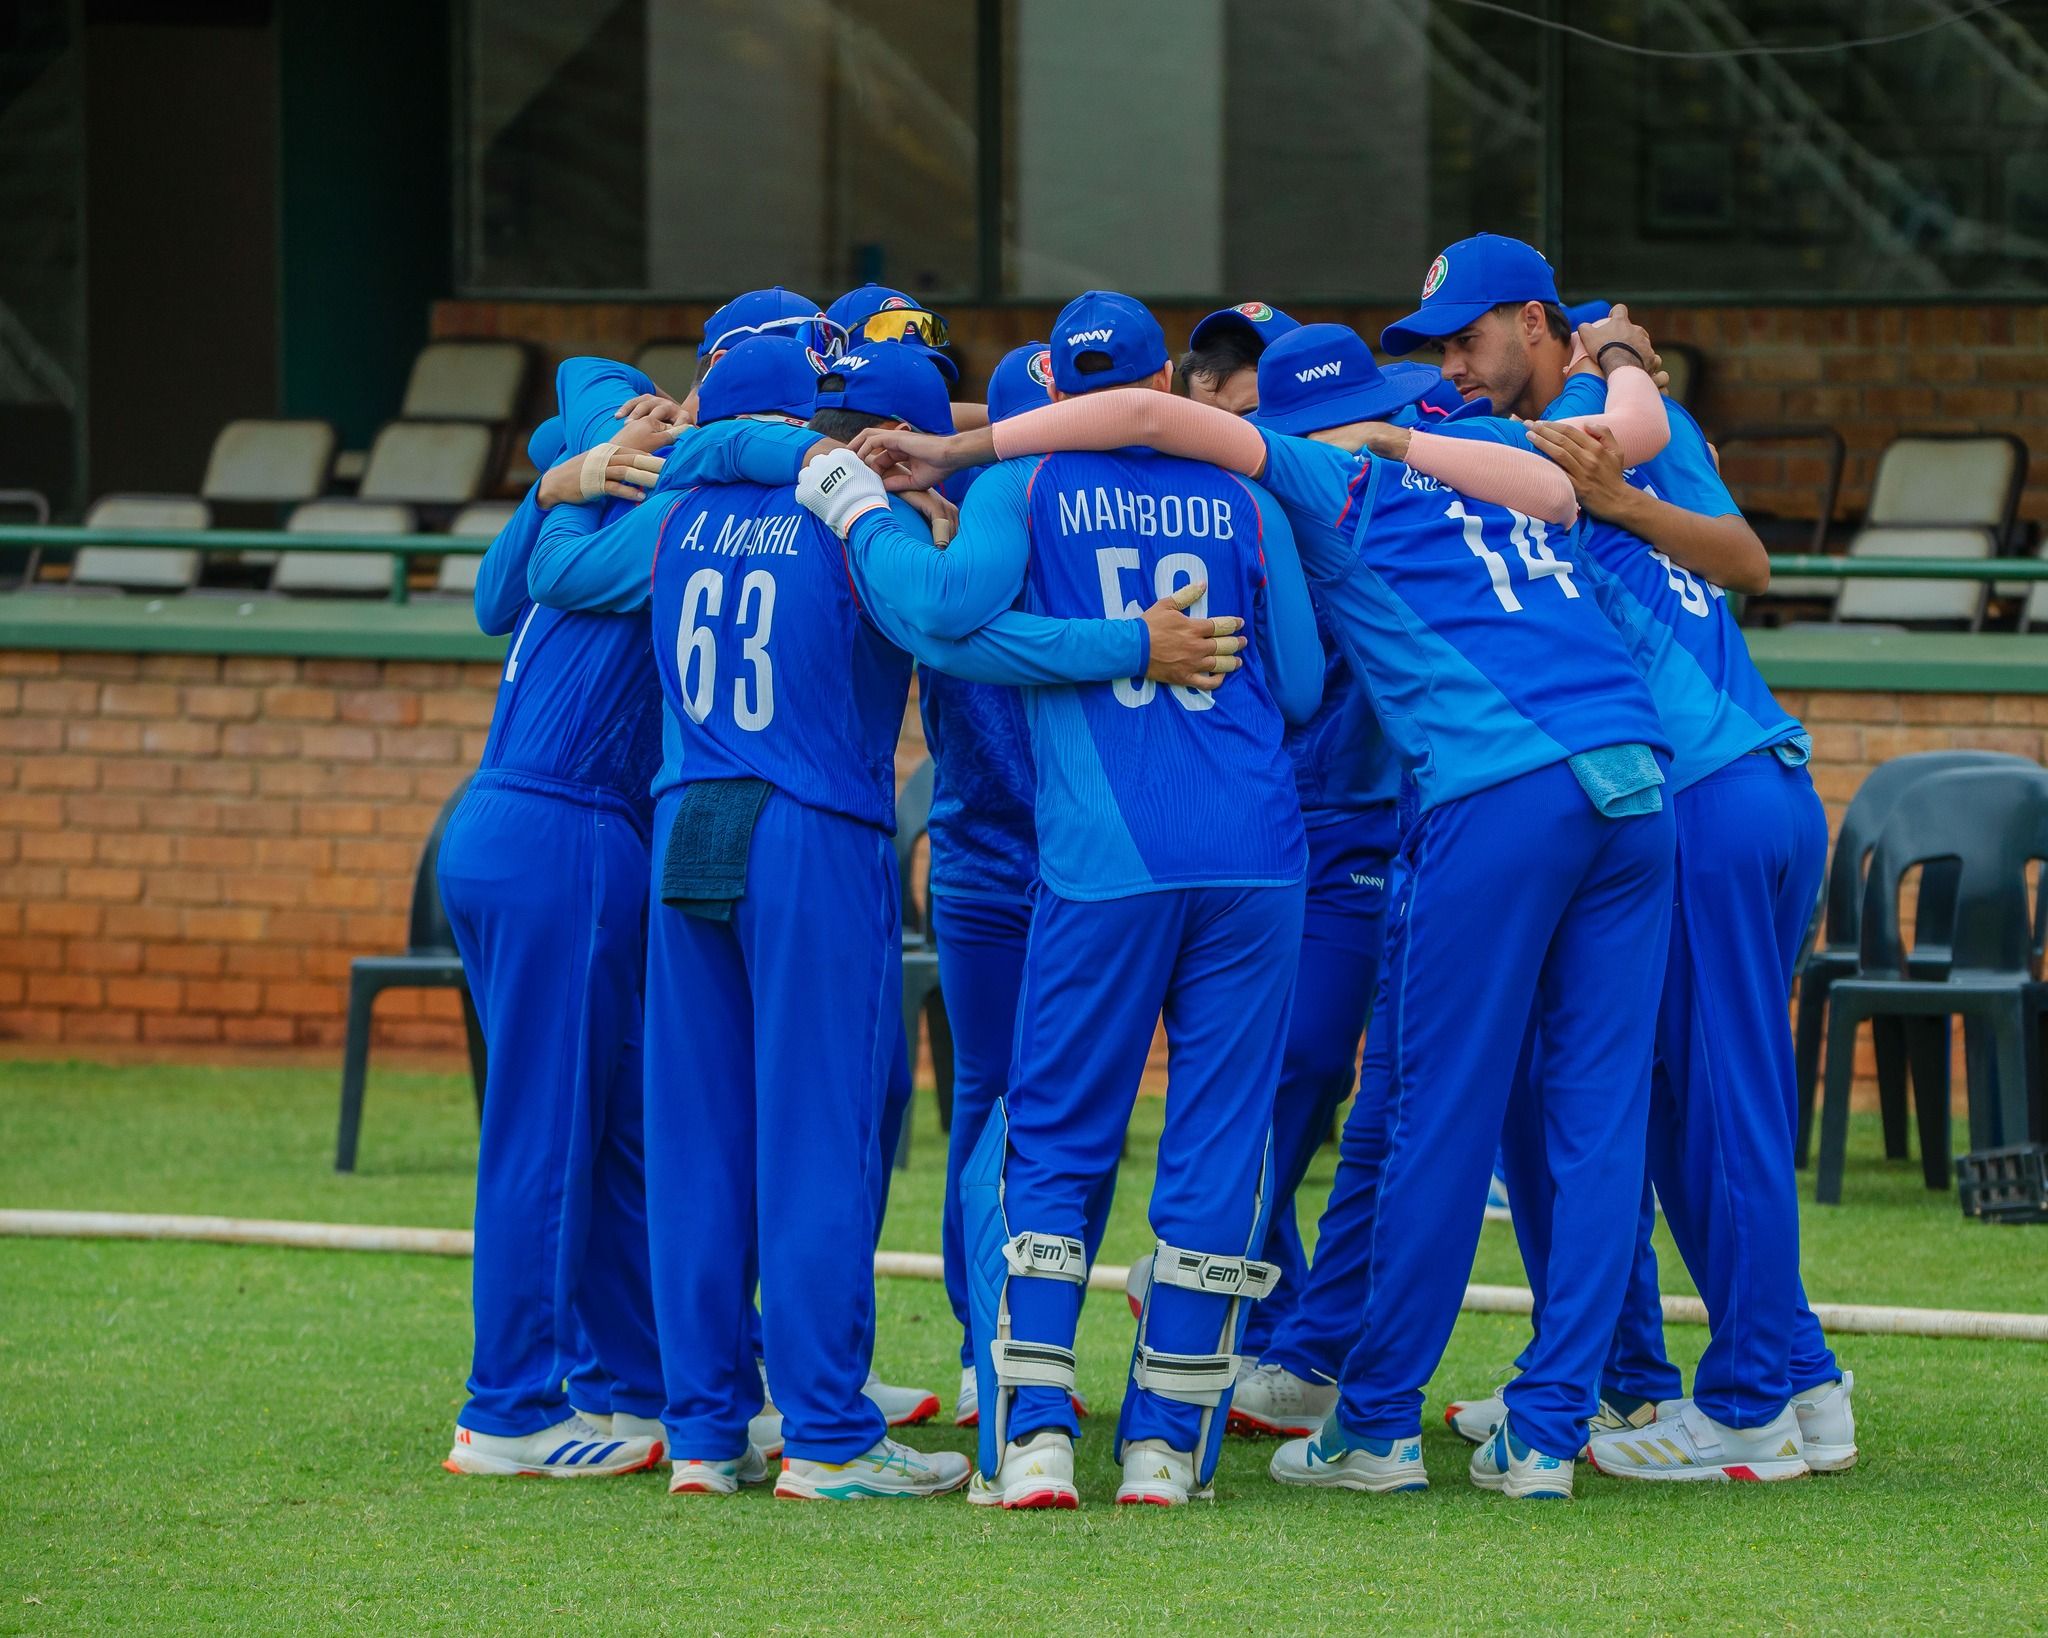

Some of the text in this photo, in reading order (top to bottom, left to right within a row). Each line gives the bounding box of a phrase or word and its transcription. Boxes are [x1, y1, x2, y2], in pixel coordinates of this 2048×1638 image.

[680, 511, 803, 558] A. MAKHIL
[1058, 486, 1234, 541] MAHBOOB
[1444, 501, 1580, 613] 14
[676, 568, 777, 732] 63
